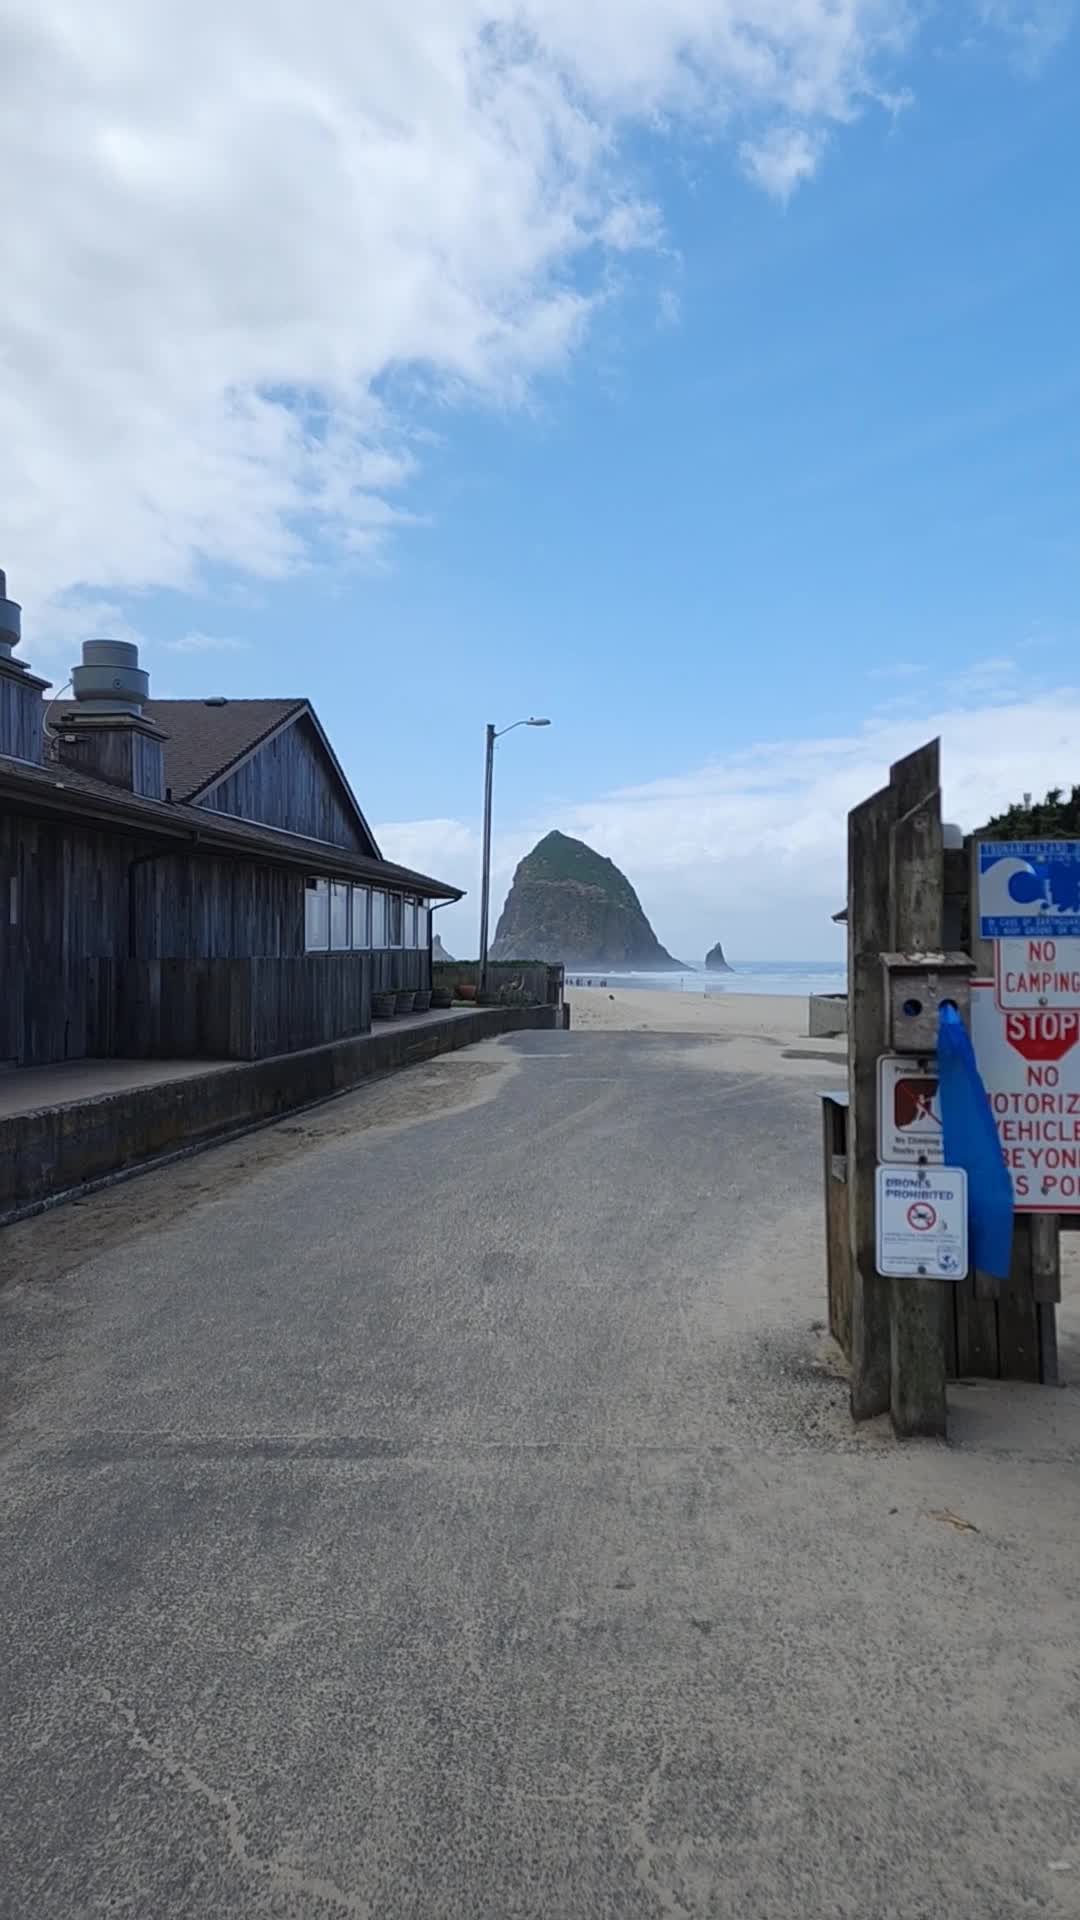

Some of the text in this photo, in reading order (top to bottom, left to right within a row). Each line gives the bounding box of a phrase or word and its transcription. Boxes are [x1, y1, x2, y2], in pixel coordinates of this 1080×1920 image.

[1029, 942, 1056, 961] NO
[1006, 972, 1080, 993] CAMPING
[1009, 1014, 1076, 1041] STOP
[1028, 1066, 1059, 1087] NO
[1002, 1148, 1080, 1168] BEYON
[886, 1179, 931, 1189] DRONES
[886, 1189, 954, 1200] PROHIBITED
